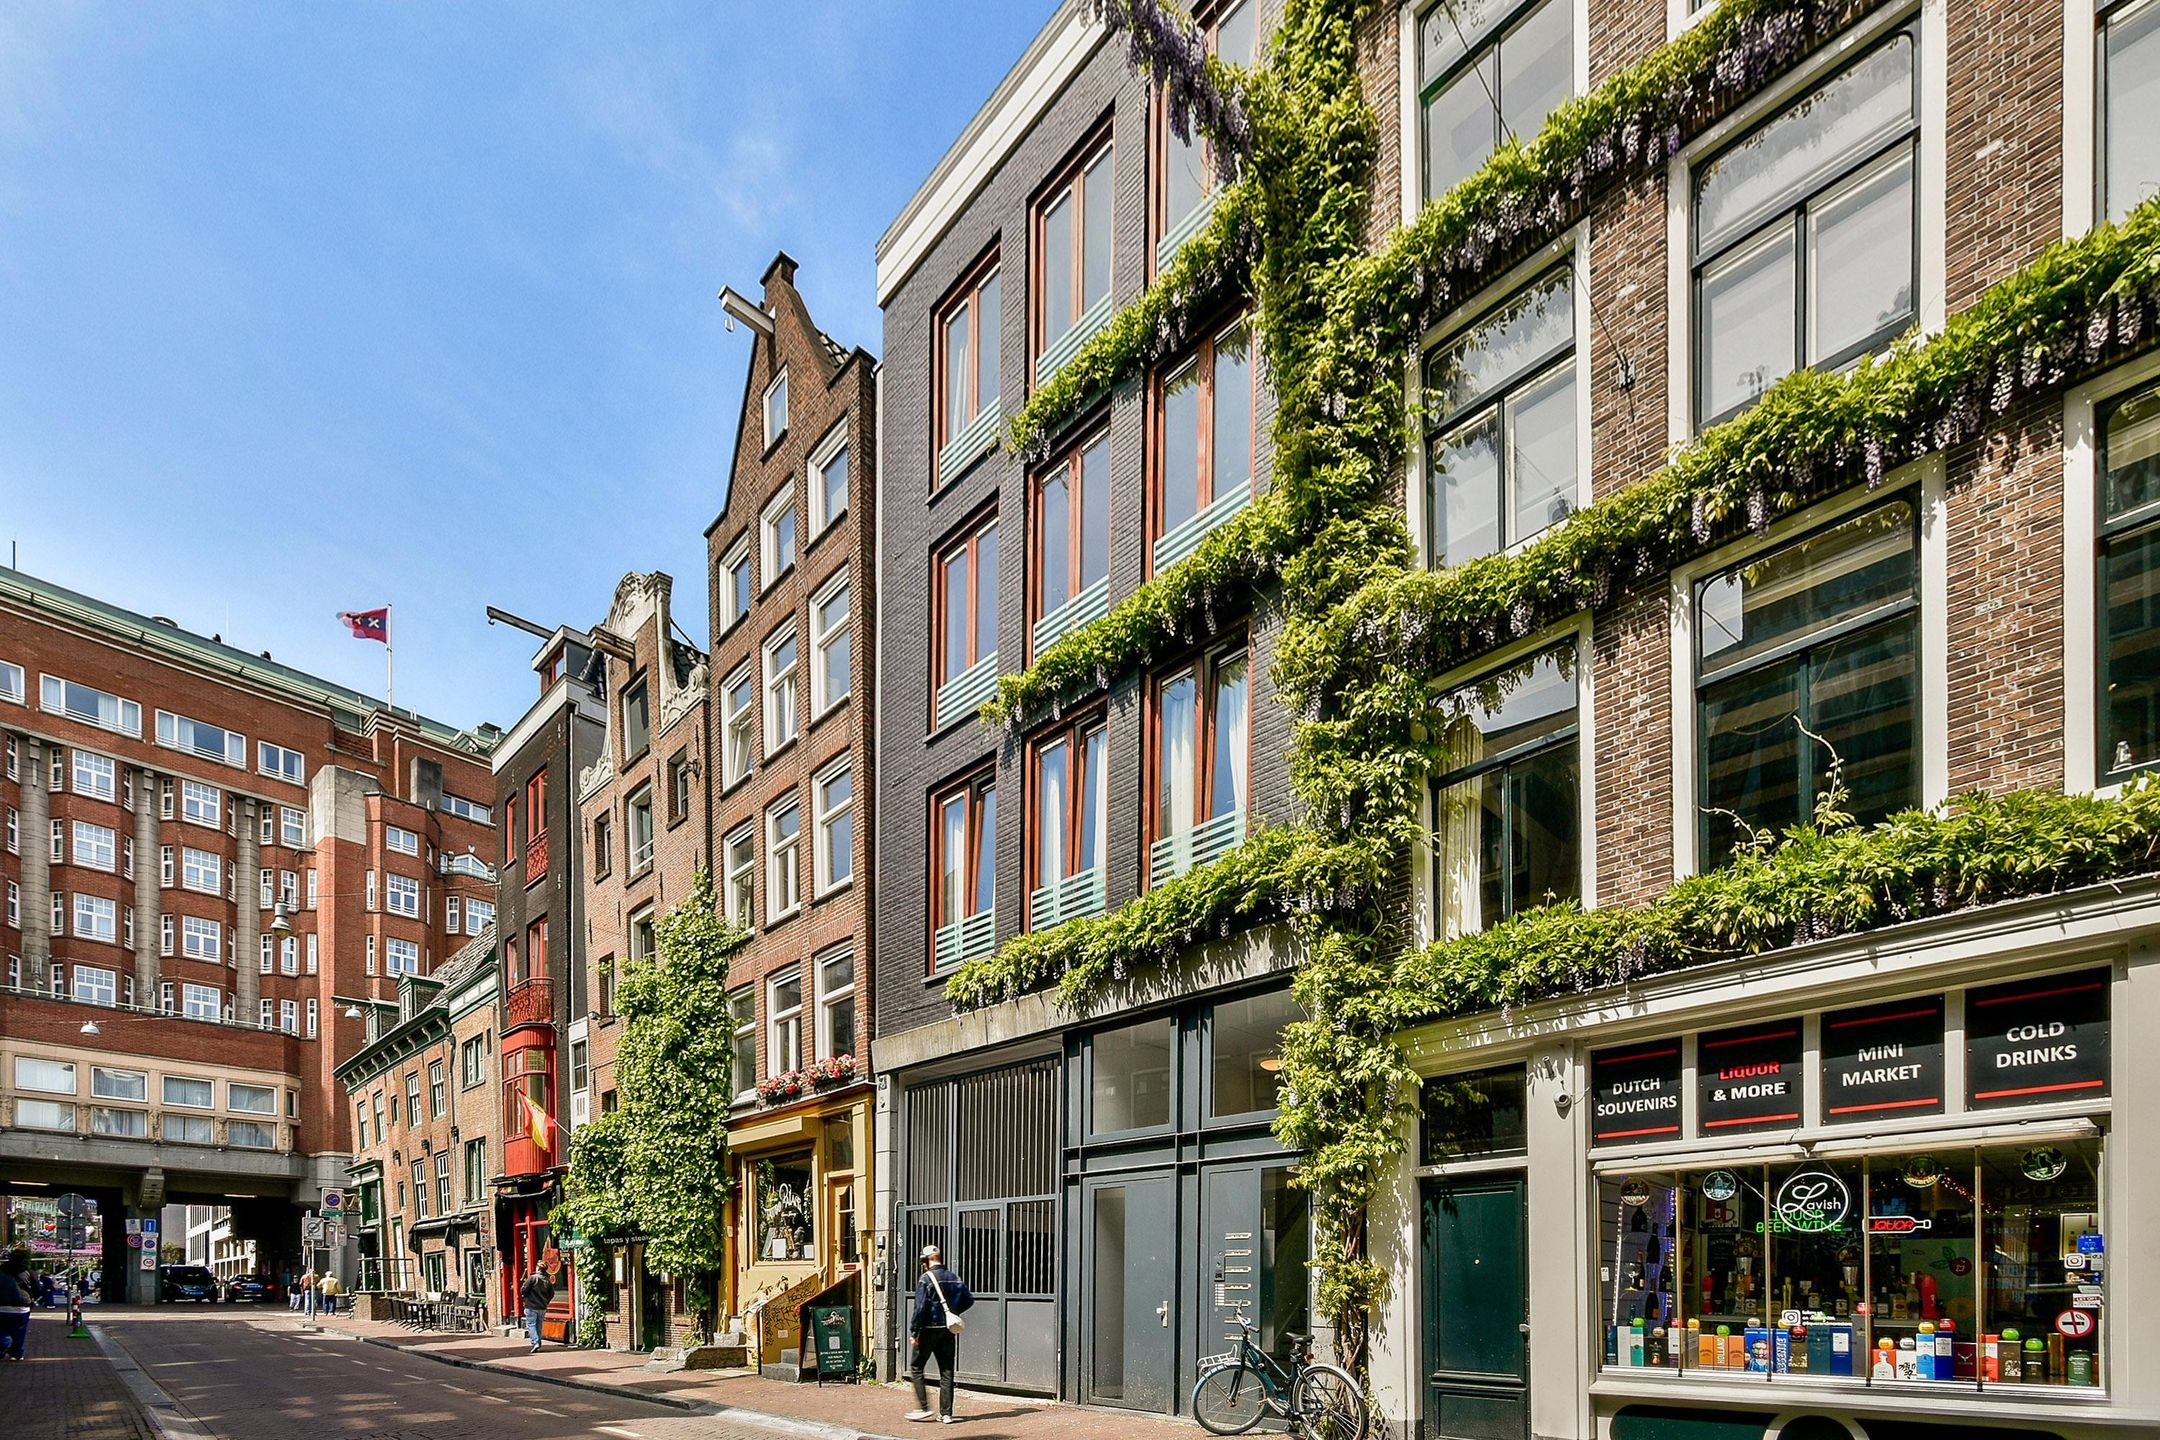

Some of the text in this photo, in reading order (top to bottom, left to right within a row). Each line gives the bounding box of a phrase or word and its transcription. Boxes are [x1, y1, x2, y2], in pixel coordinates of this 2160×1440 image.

[2006, 1022, 2065, 1043] COLD
[1858, 1043, 1904, 1062] MINI
[1996, 1045, 2078, 1068] DRINKS
[1719, 1061, 1781, 1081] LIQUOR
[1842, 1064, 1922, 1087] MARKET
[1612, 1077, 1661, 1096] DUTCH
[1713, 1082, 1786, 1102] & MORE
[1597, 1095, 1678, 1117] SOUVENIRS
[1782, 1182, 1841, 1218] Lavish
[1768, 1209, 1825, 1222] IQUOR
[1798, 1221, 1843, 1233] WINE
[603, 1237, 624, 1245] tapas
